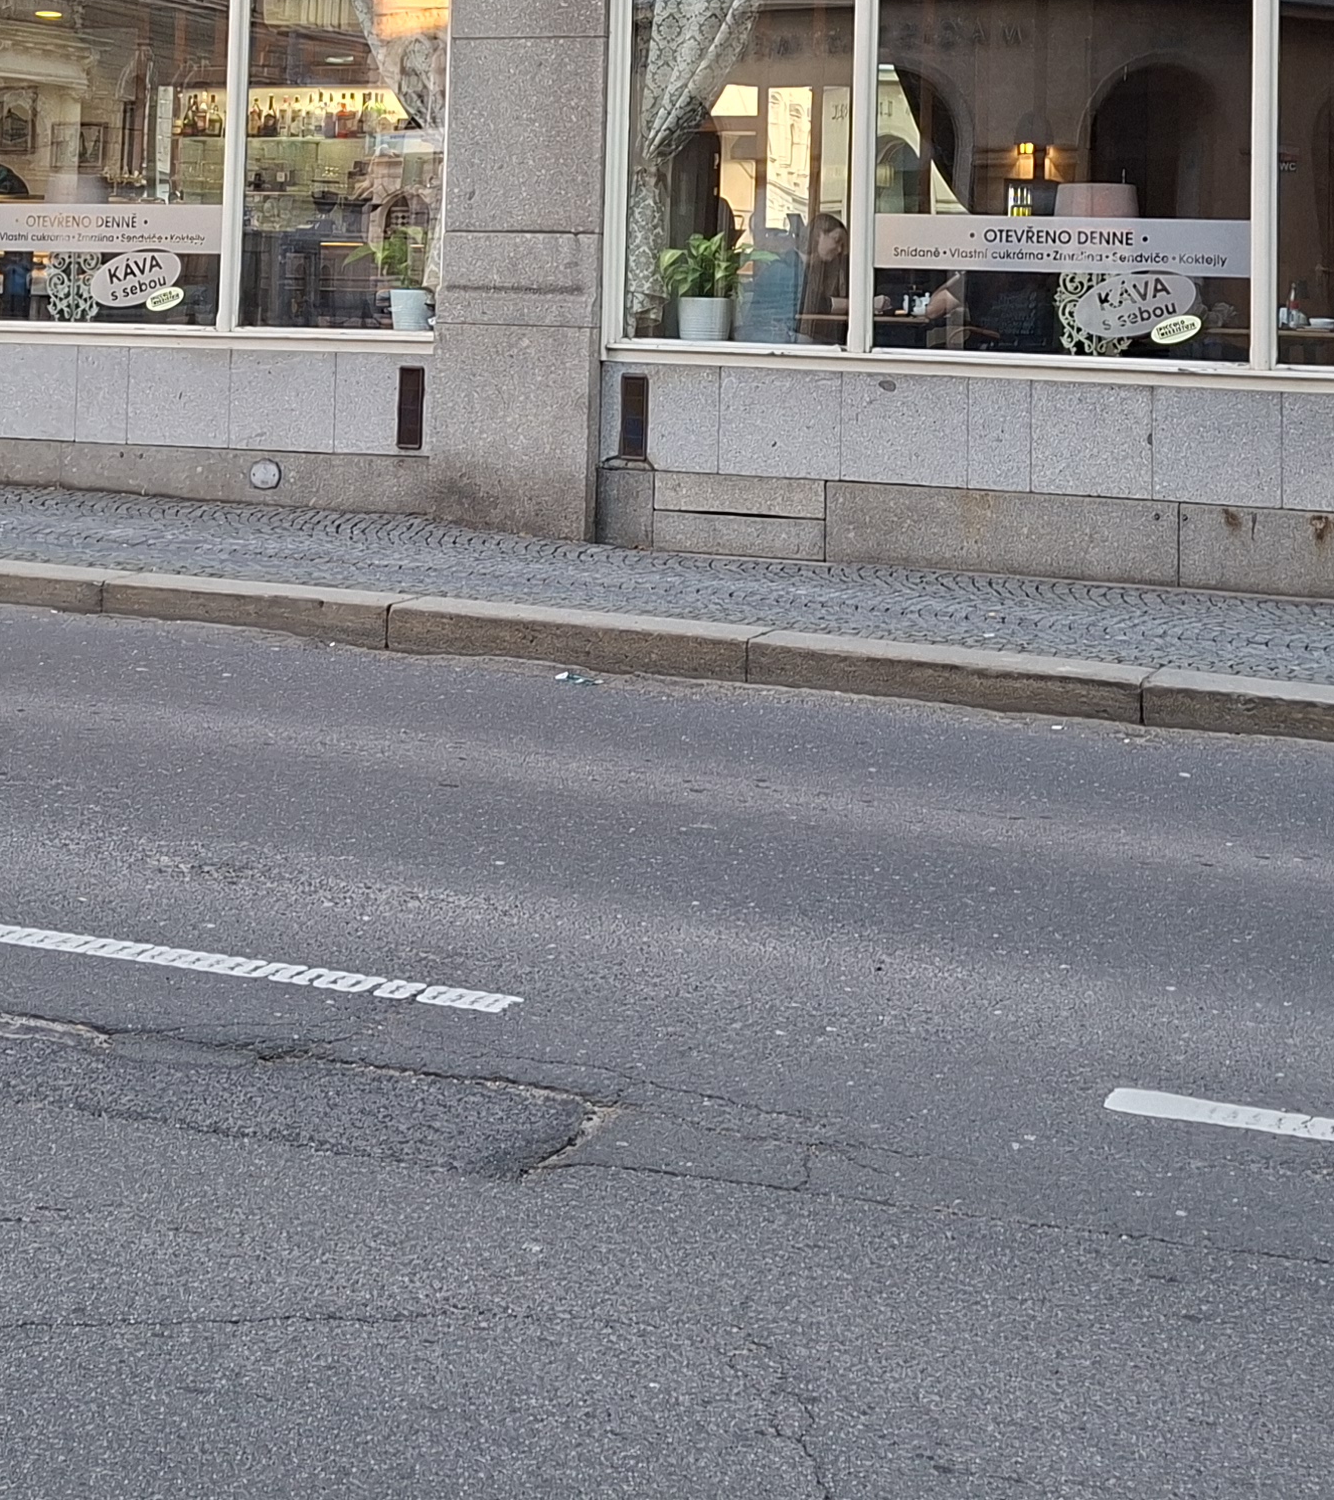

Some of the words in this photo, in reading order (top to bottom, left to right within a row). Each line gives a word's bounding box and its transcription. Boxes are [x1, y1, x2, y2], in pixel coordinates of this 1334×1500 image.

[25, 212, 92, 228] OTEVŘENO
[96, 212, 137, 228] DENNĚ
[983, 226, 1072, 245] OTEVŘENO
[107, 254, 163, 285] KÁVA
[893, 245, 941, 259] Snídaně
[948, 247, 989, 260] Vlastní
[991, 248, 1044, 261] cukrárna
[1178, 252, 1228, 268] Koktejly
[110, 290, 119, 301] s
[122, 275, 167, 298] sebou
[1096, 276, 1172, 311] KÁVA
[1102, 319, 1112, 331] s
[1117, 302, 1178, 328] sebou
